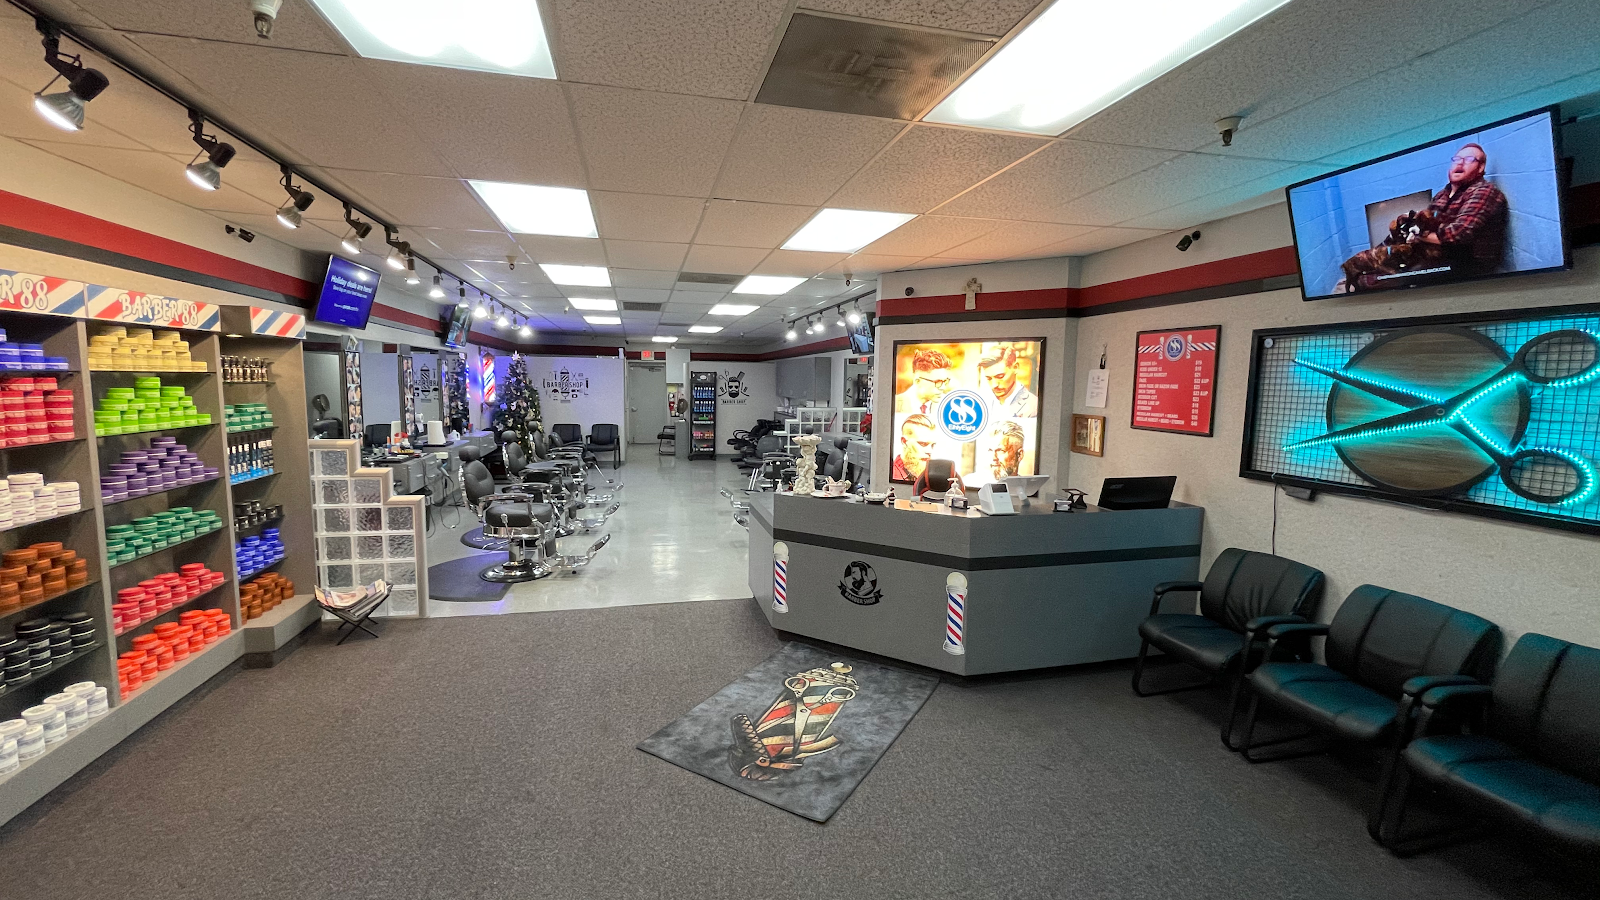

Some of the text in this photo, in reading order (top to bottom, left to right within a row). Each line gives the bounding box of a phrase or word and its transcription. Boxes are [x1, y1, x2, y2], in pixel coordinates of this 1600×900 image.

[20, 278, 48, 310] 88
[118, 293, 198, 326] BARBER 88
